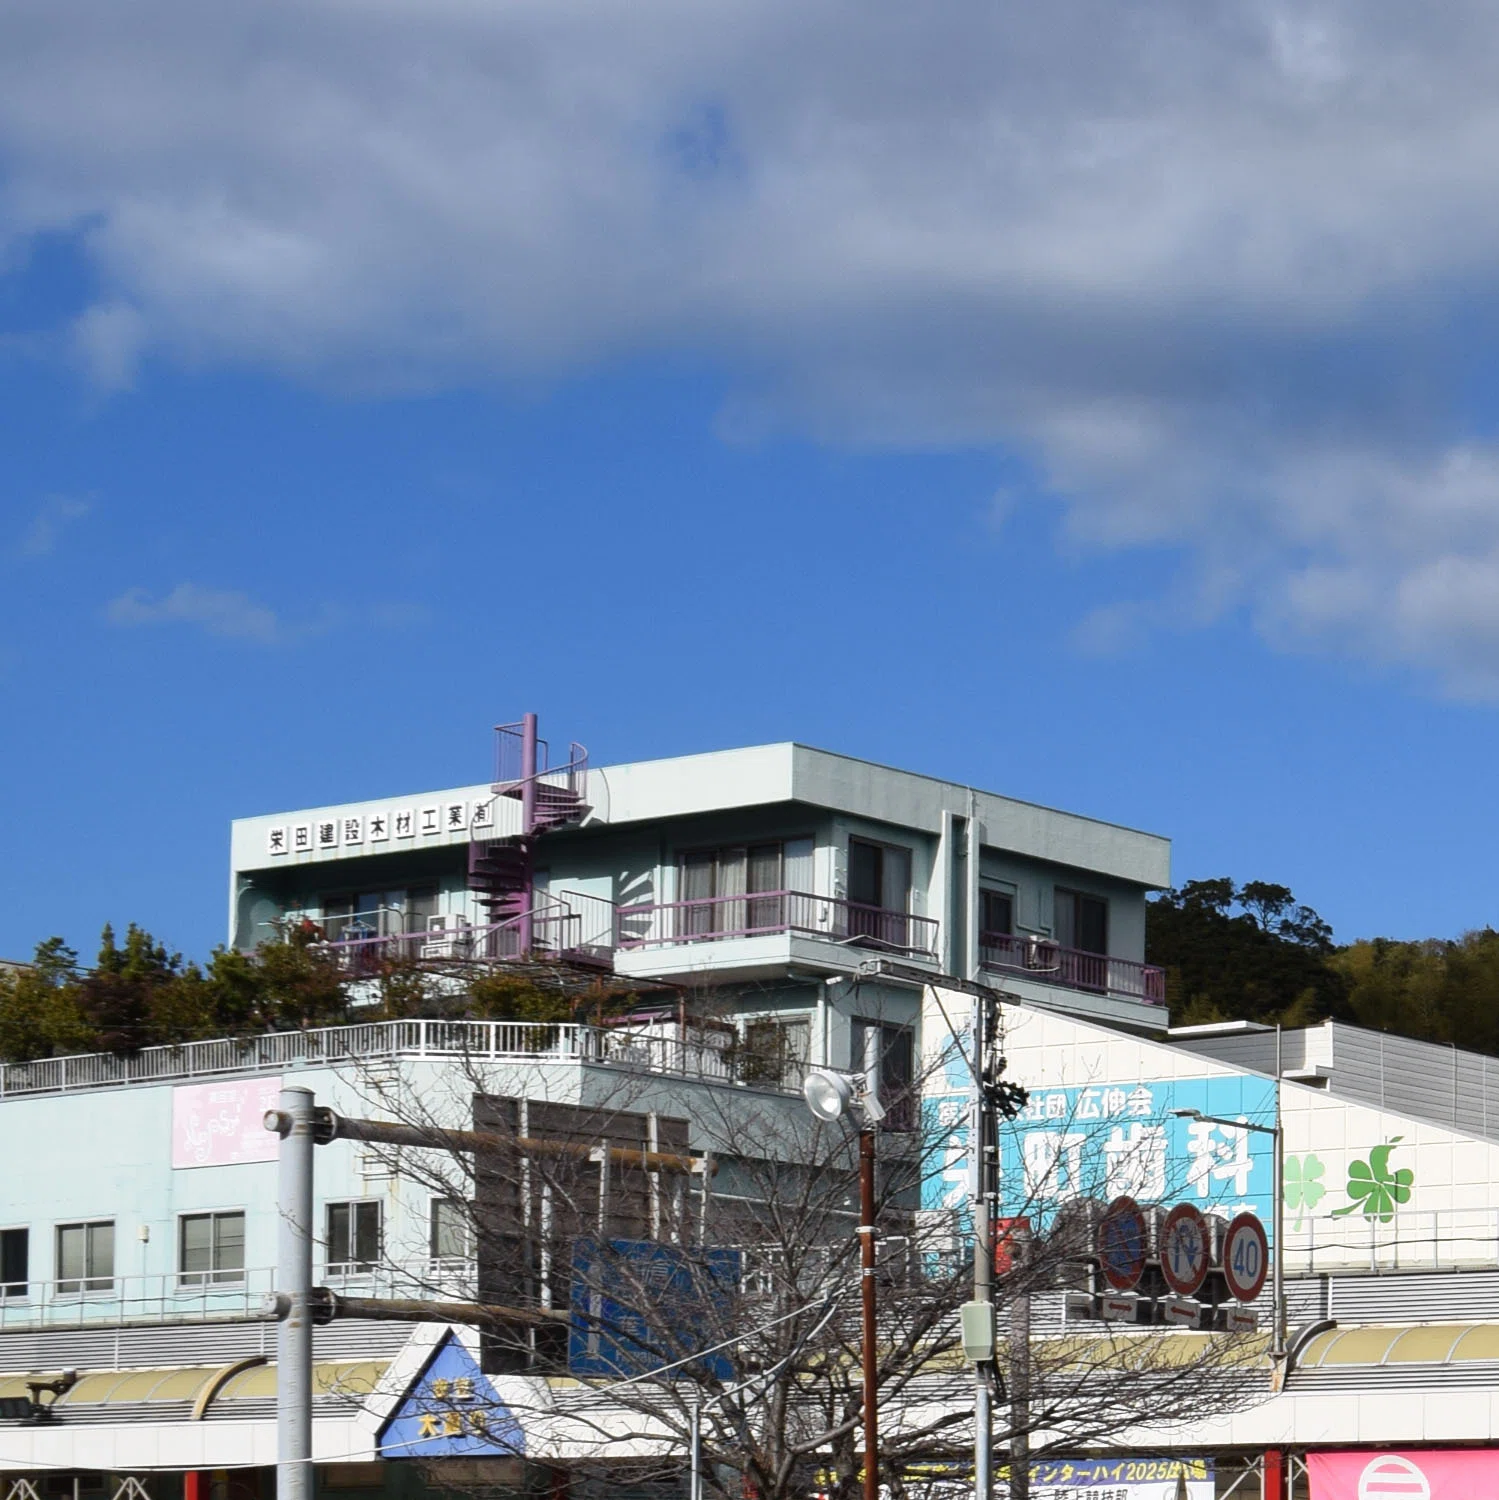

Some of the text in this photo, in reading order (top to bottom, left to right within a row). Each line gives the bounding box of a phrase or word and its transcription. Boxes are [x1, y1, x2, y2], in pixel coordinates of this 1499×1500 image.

[1074, 1085, 1154, 1119] 広伸会
[1233, 1237, 1257, 1276] 40
